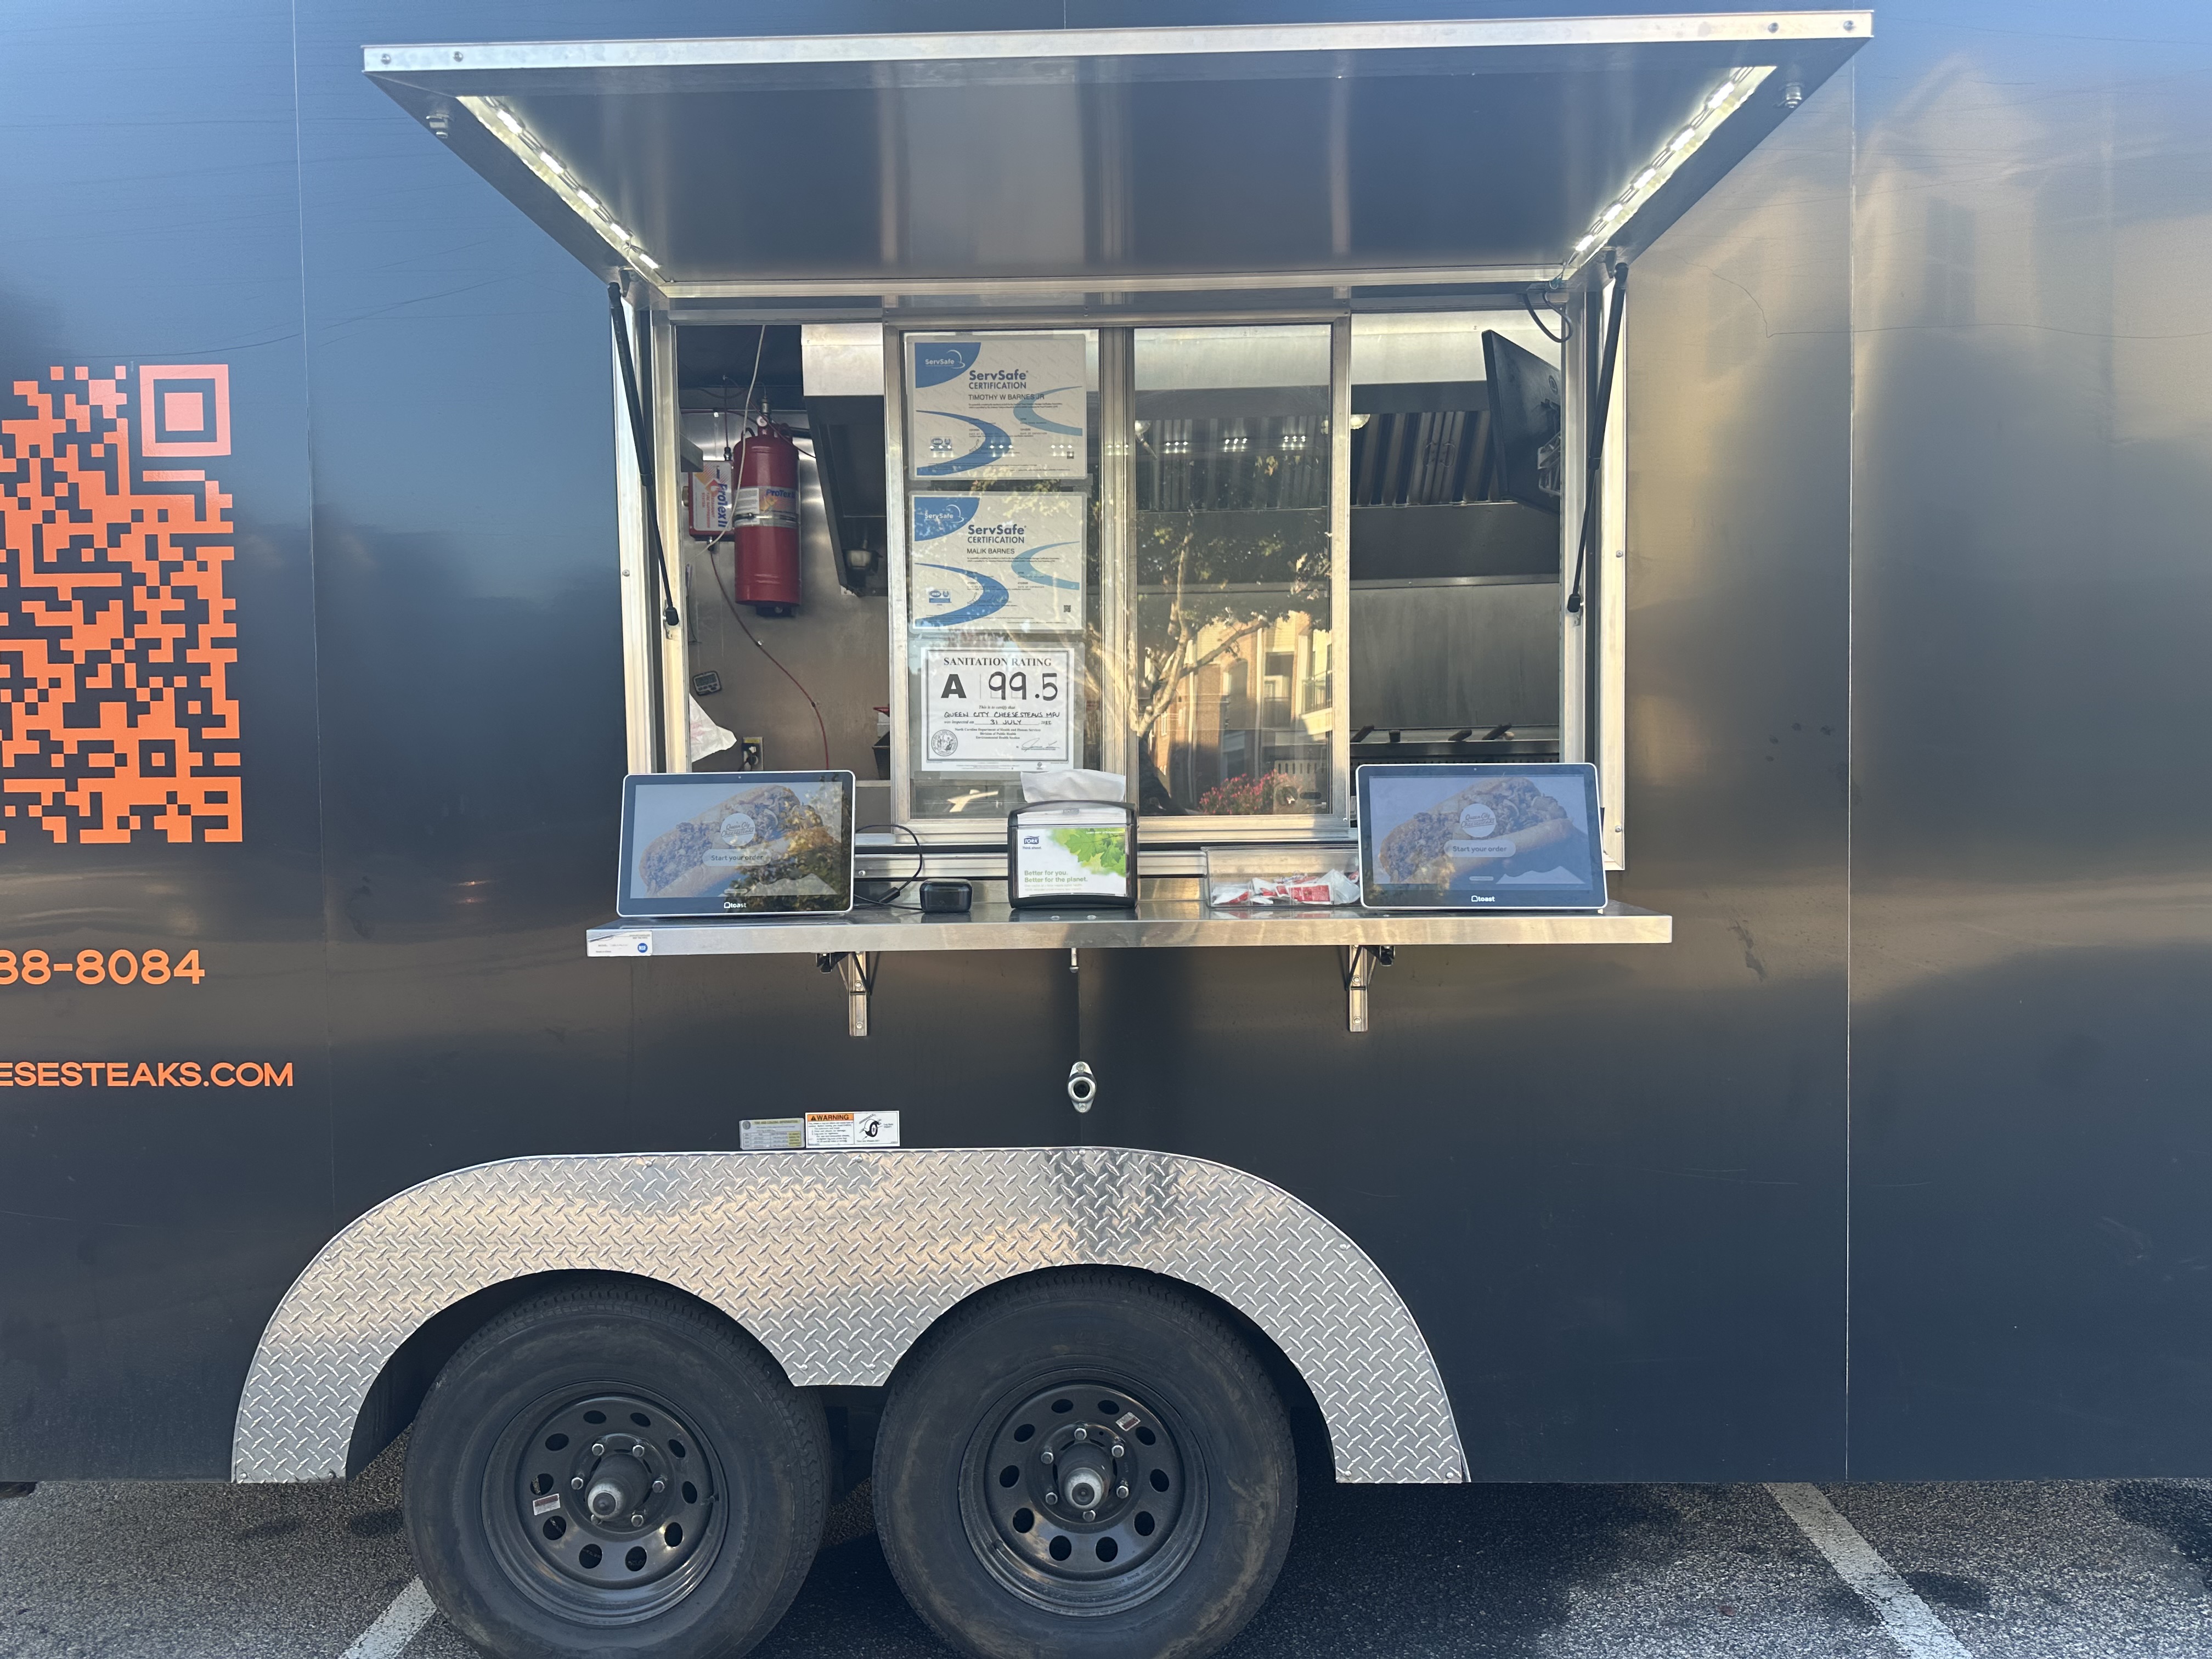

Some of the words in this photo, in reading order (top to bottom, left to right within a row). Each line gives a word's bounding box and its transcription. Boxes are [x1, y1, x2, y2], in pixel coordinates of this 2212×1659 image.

[969, 369, 1026, 381] ServSafe
[968, 524, 1025, 535] ServSafe
[944, 657, 1008, 666] SANITATION
[1012, 658, 1052, 667] RATING
[941, 674, 967, 698] A
[0, 949, 205, 985] 88-8084
[0, 1062, 294, 1087] ESESTEAKS.COM
